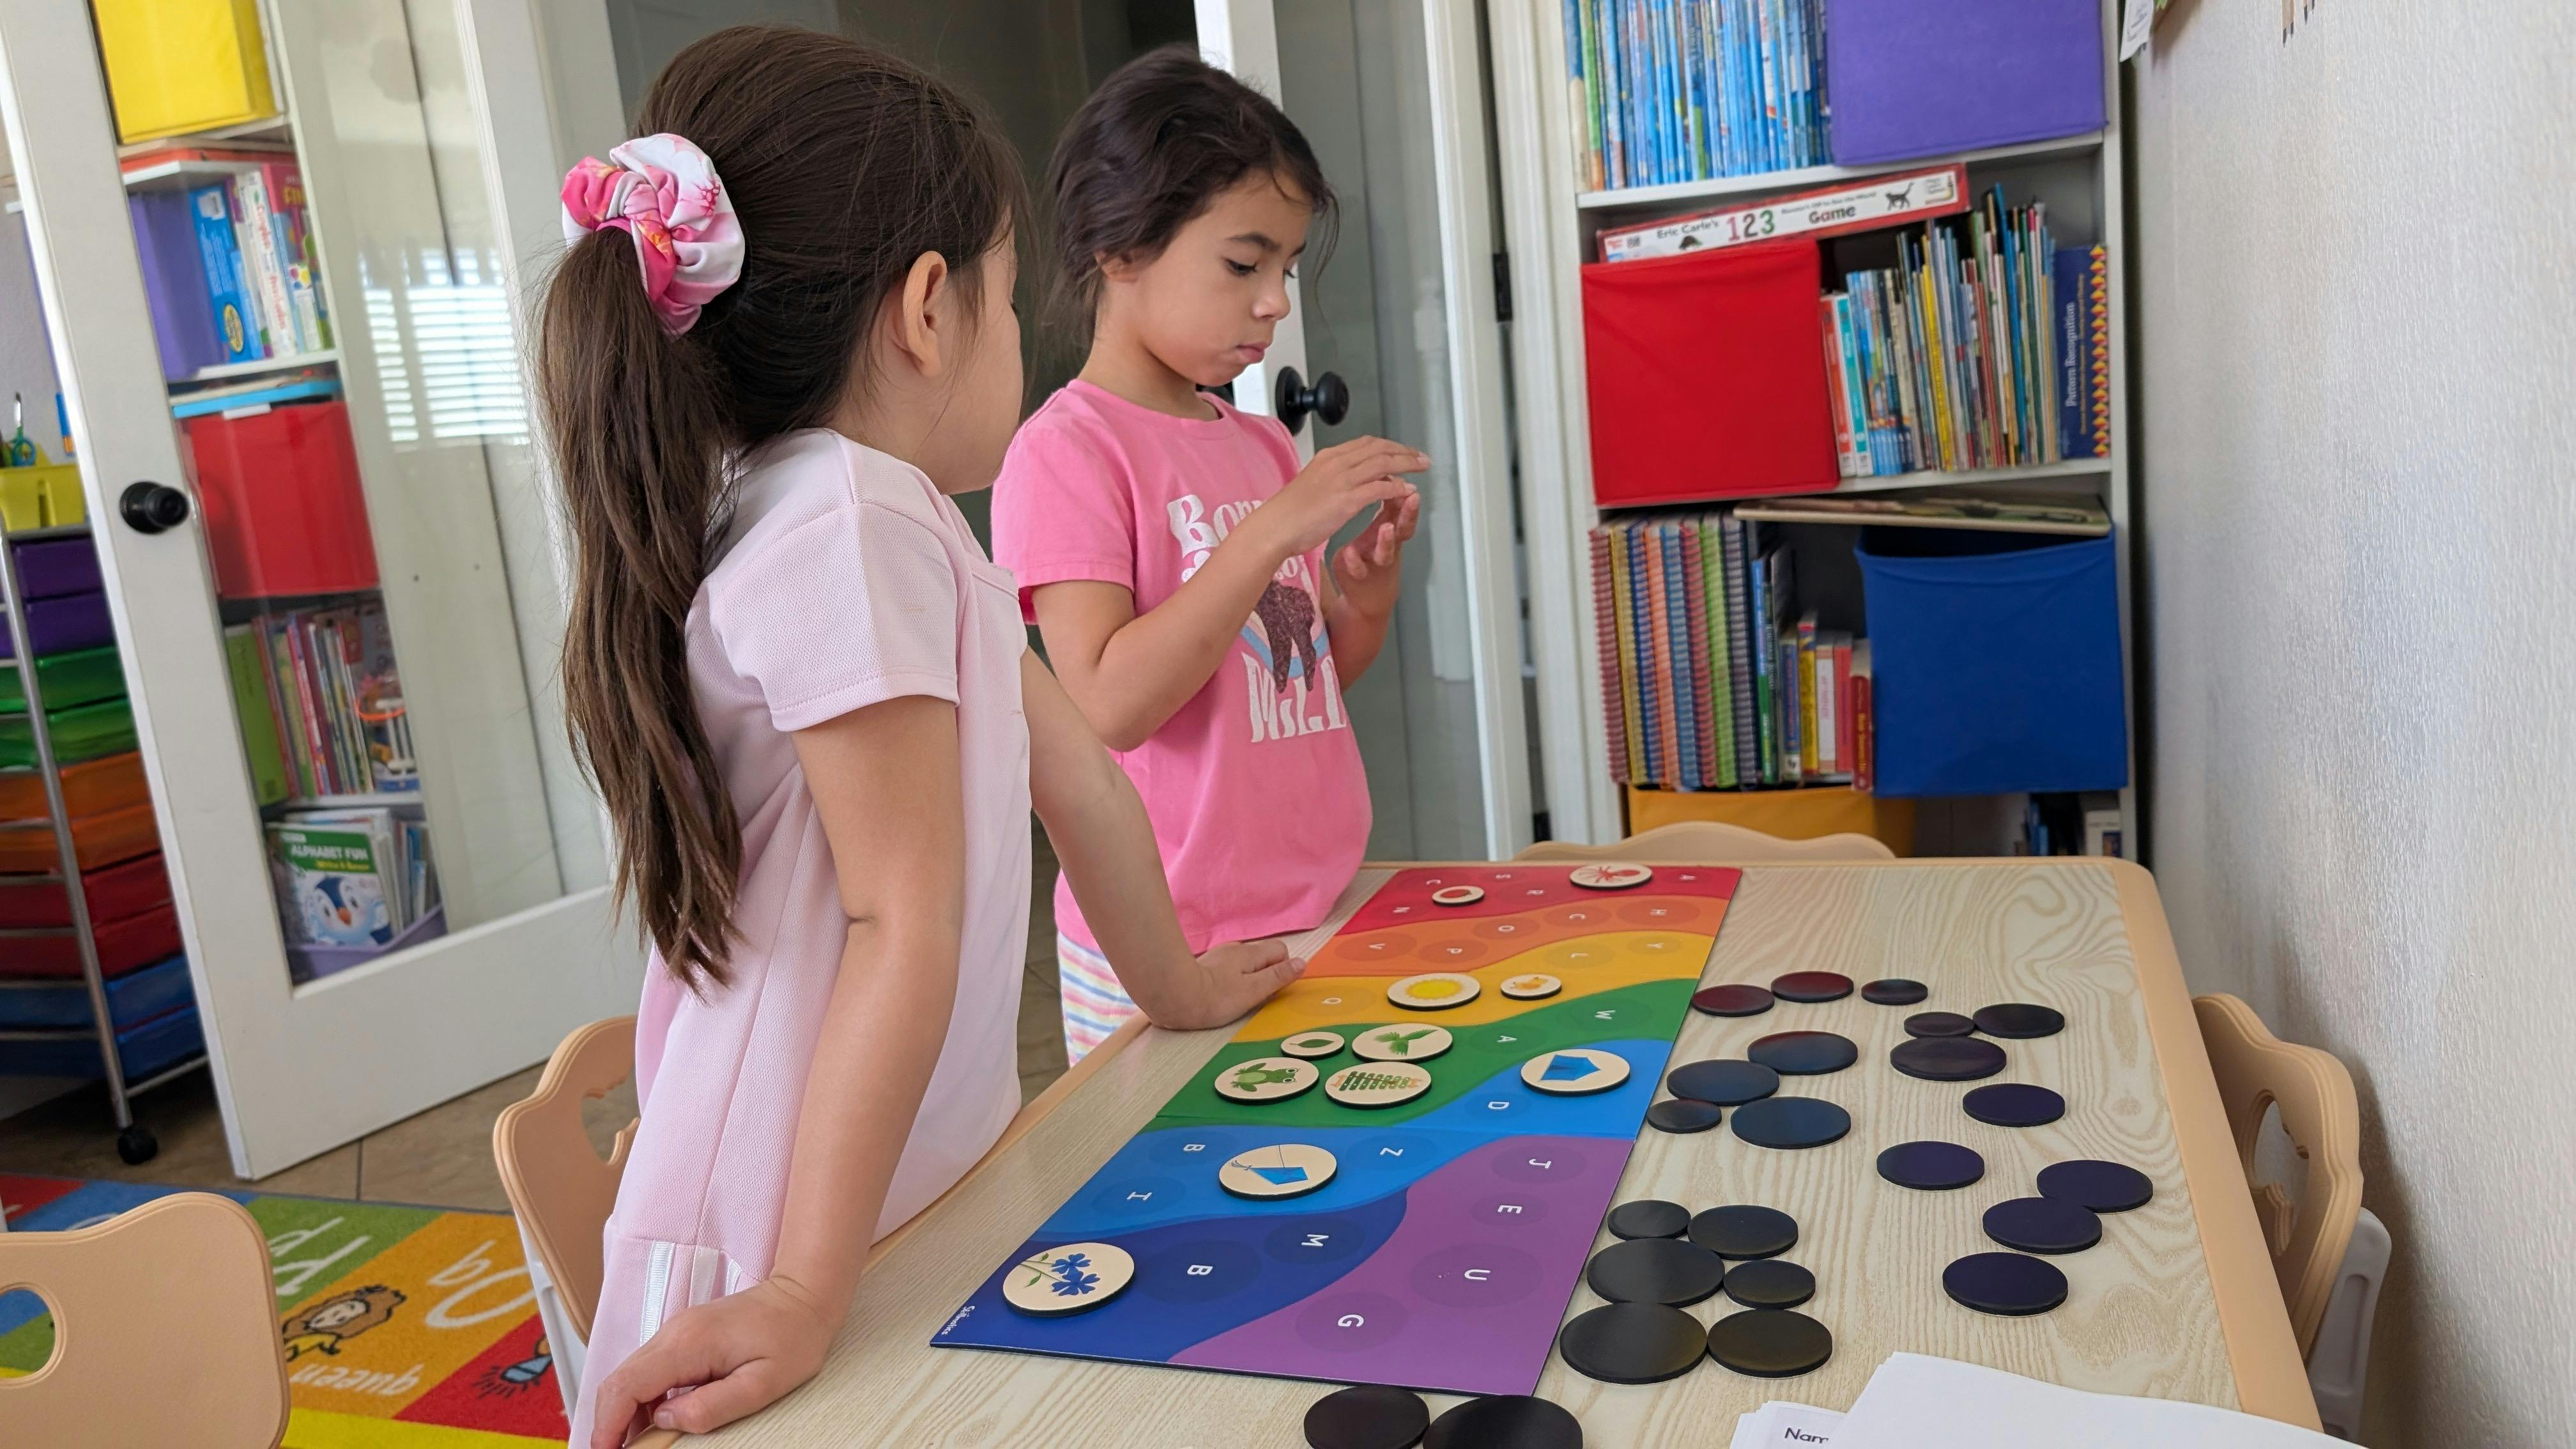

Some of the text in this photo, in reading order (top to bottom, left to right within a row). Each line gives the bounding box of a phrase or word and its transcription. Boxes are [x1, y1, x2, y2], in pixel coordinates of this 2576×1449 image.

[1809, 205, 1857, 224] Game
[1594, 1009, 1616, 1020] W
[1496, 1035, 1517, 1043] A
[1487, 1101, 1510, 1110] D
[1528, 1158, 1552, 1169] J
[1126, 1192, 1153, 1201] I
[1496, 1204, 1522, 1214] E
[1300, 1233, 1330, 1246] M
[1186, 1264, 1213, 1275] B
[1463, 1269, 1491, 1280] U
[1337, 1314, 1365, 1327] G
[289, 1363, 424, 1397] queen
